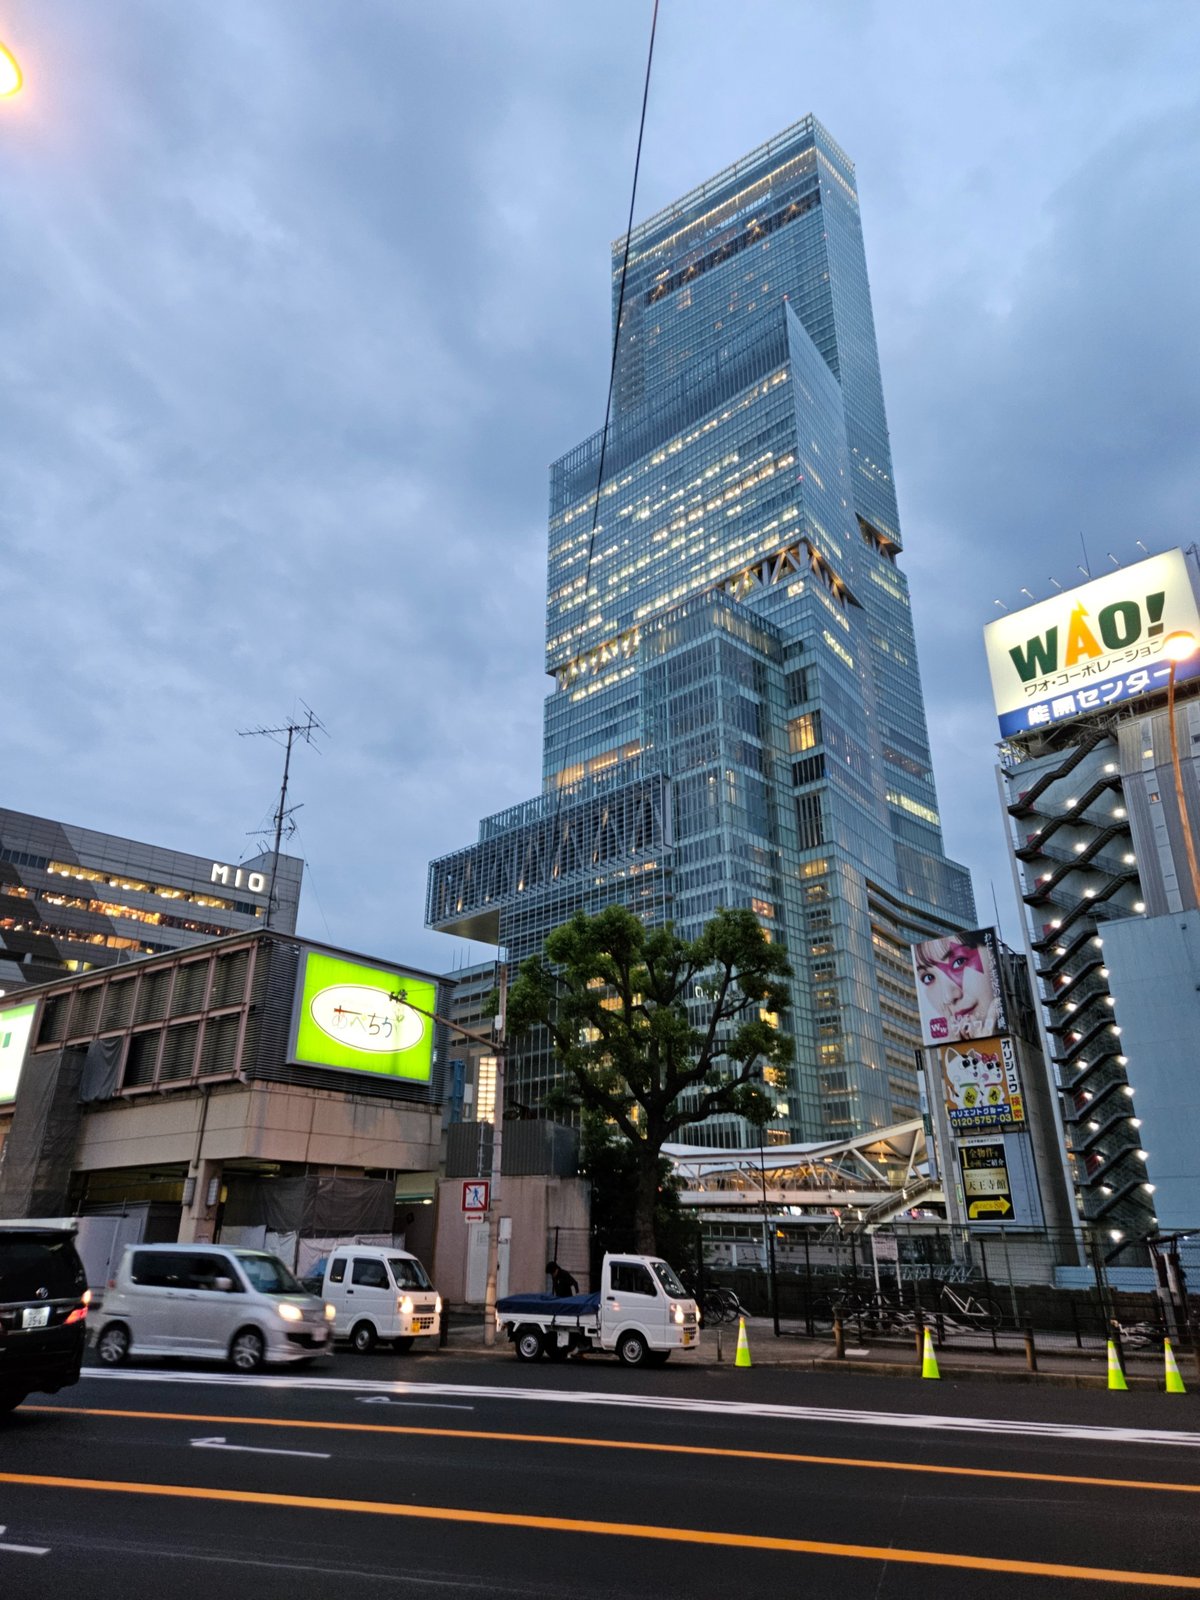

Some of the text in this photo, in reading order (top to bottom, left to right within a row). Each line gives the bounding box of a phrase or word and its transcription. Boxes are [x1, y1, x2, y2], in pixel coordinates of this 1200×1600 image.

[1008, 591, 1165, 683] WAO!
[1027, 667, 1173, 726] 能開センター
[211, 863, 264, 892] MIO
[1001, 1040, 1018, 1093] オリジュウ
[968, 1178, 1006, 1191] 天王寺館
